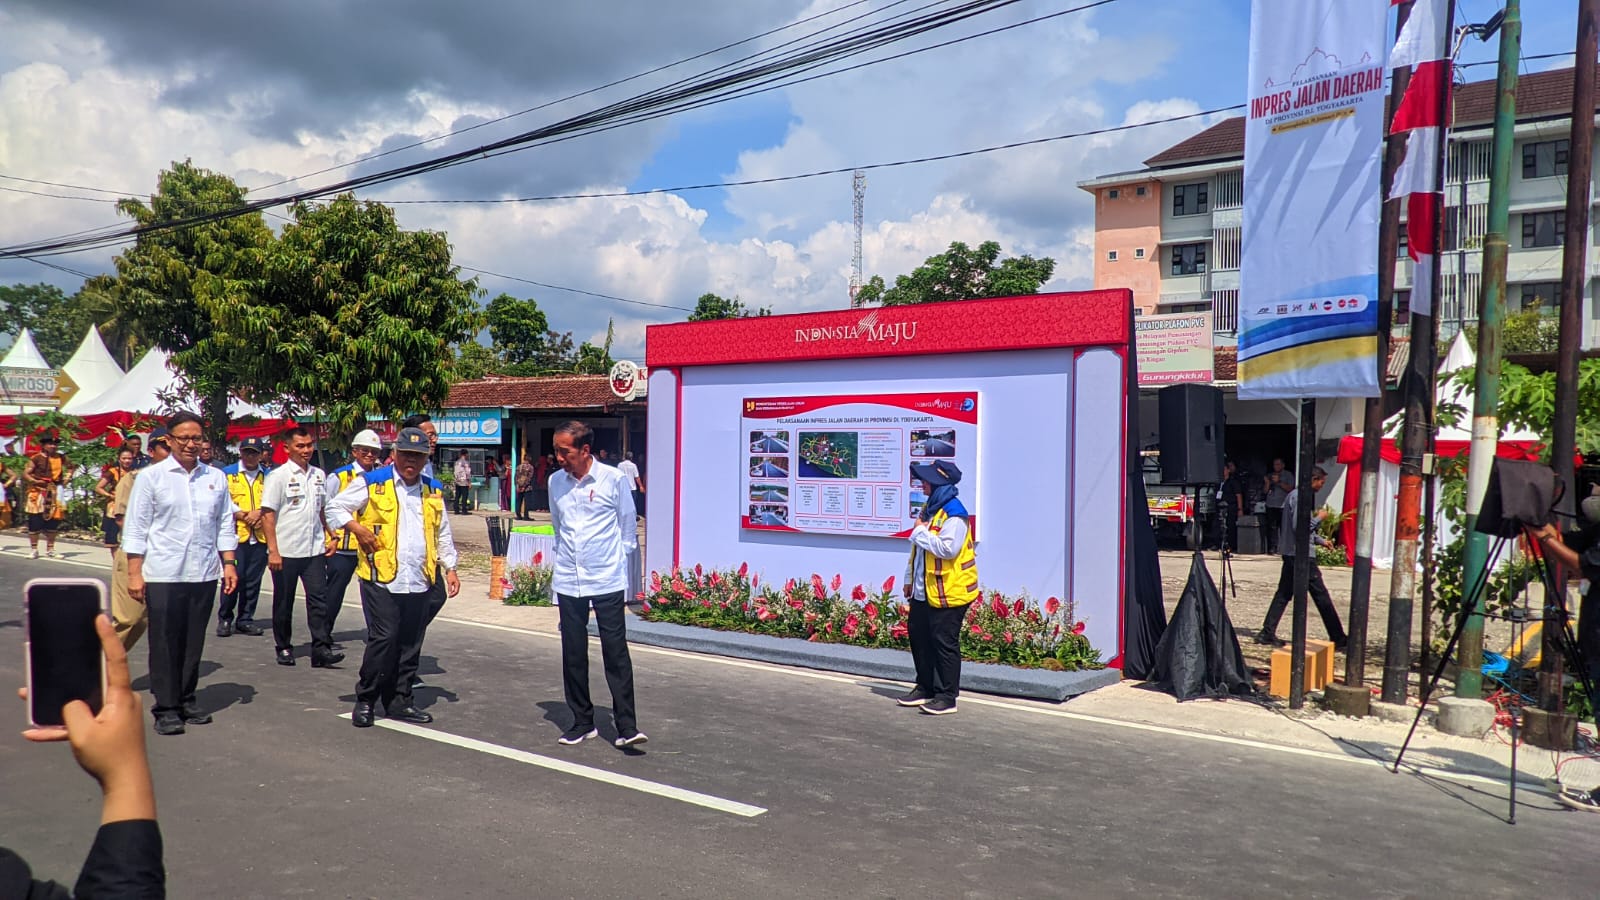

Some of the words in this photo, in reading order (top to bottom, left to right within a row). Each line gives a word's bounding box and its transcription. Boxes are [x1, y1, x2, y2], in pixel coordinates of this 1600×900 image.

[1292, 71, 1337, 87] PELAKSANAAN
[1251, 90, 1291, 120] INPRES
[1293, 79, 1331, 109] JALAN
[1333, 67, 1383, 99] DAERAH
[1274, 110, 1304, 123] PROVINSI
[1316, 96, 1364, 112] YOGYAKARTA
[867, 321, 918, 346] MAJU
[1135, 319, 1164, 331] PLIKATOR
[1165, 318, 1189, 329] PLAFON
[1191, 316, 1205, 328] PVC
